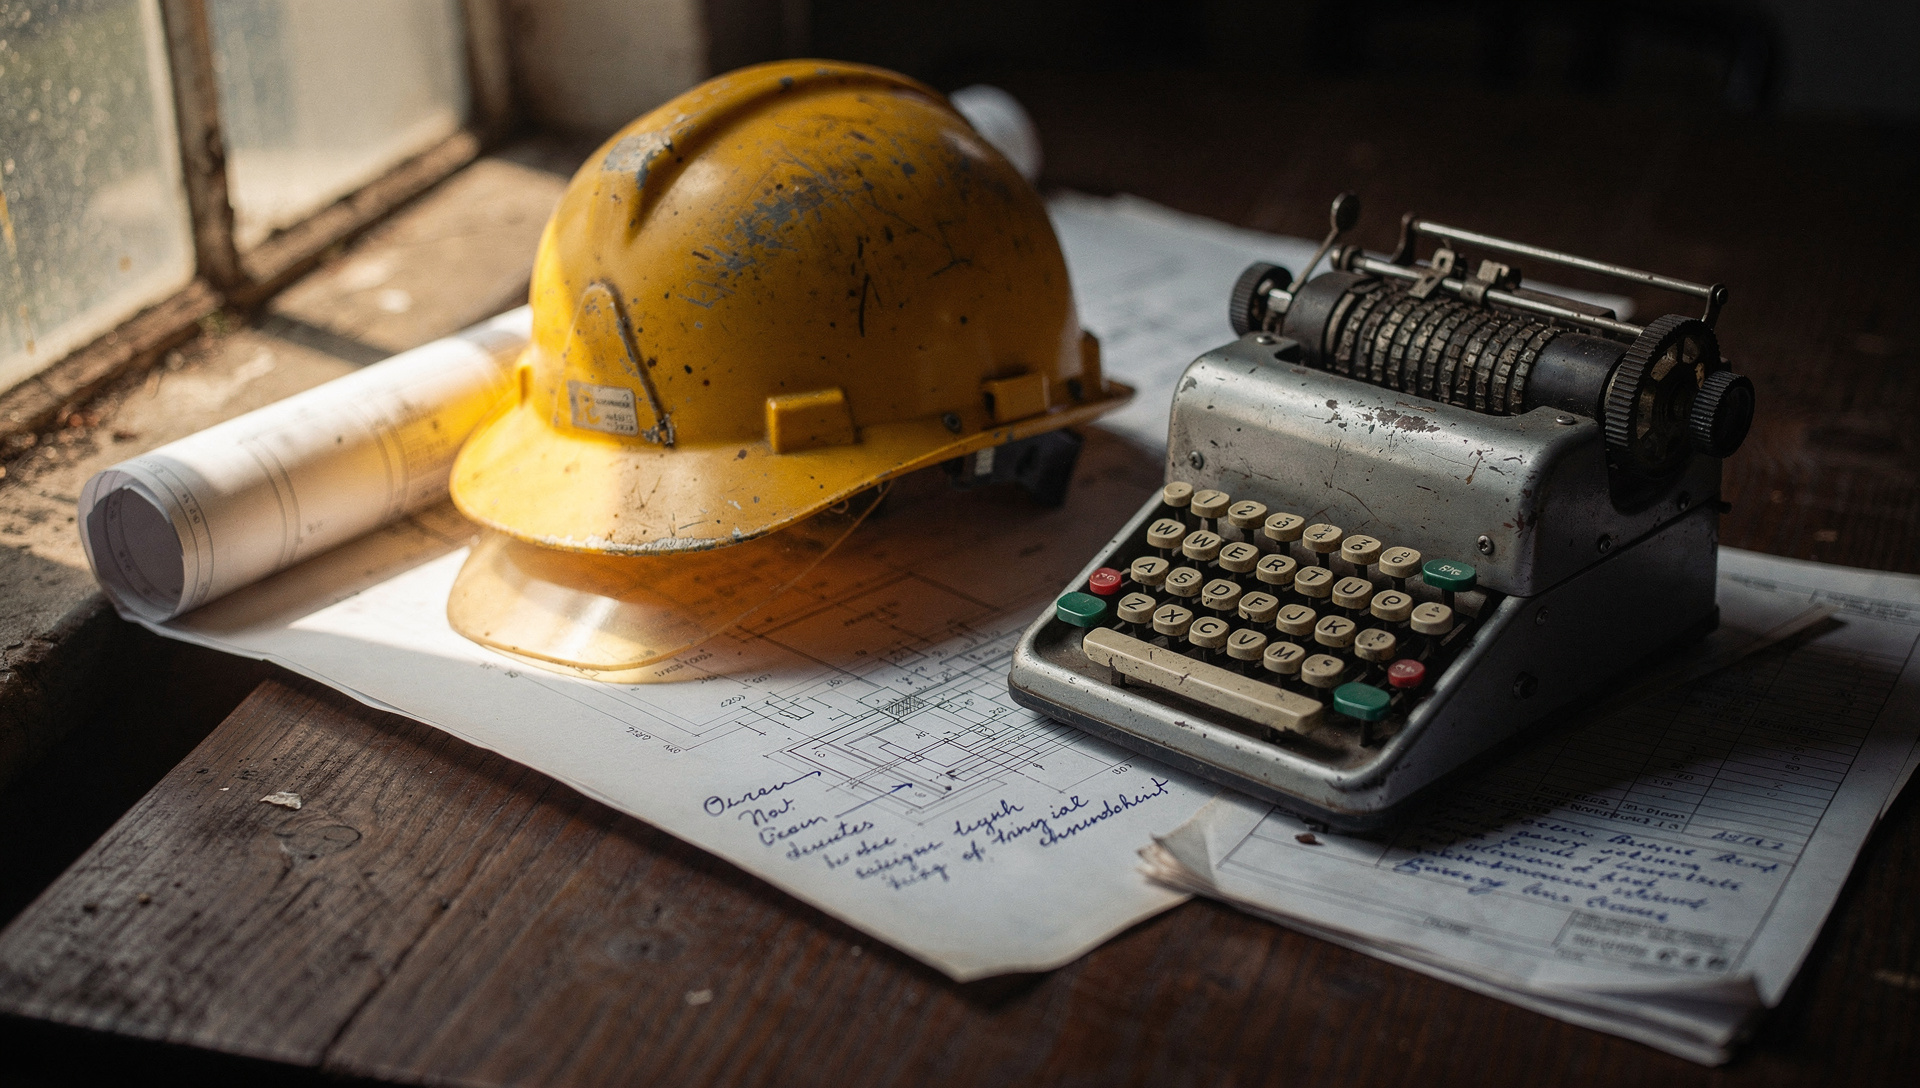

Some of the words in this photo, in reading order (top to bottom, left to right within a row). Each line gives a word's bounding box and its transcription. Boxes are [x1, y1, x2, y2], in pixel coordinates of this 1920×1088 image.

[1155, 522, 1179, 536] W
[1192, 533, 1215, 548] W
[1227, 546, 1248, 560] E
[1265, 559, 1287, 572] R
[1306, 570, 1324, 582] T
[1341, 581, 1364, 594] U
[1125, 597, 1147, 611] Z
[1161, 608, 1184, 623] X
[1199, 622, 1219, 634] C
[1238, 633, 1258, 645] V
[1273, 646, 1296, 660] M
[1138, 562, 1157, 574] A
[1174, 572, 1193, 584] S
[1210, 584, 1231, 596] D
[1248, 597, 1269, 607] F
[1286, 611, 1306, 621] J
[1324, 620, 1347, 635] K
